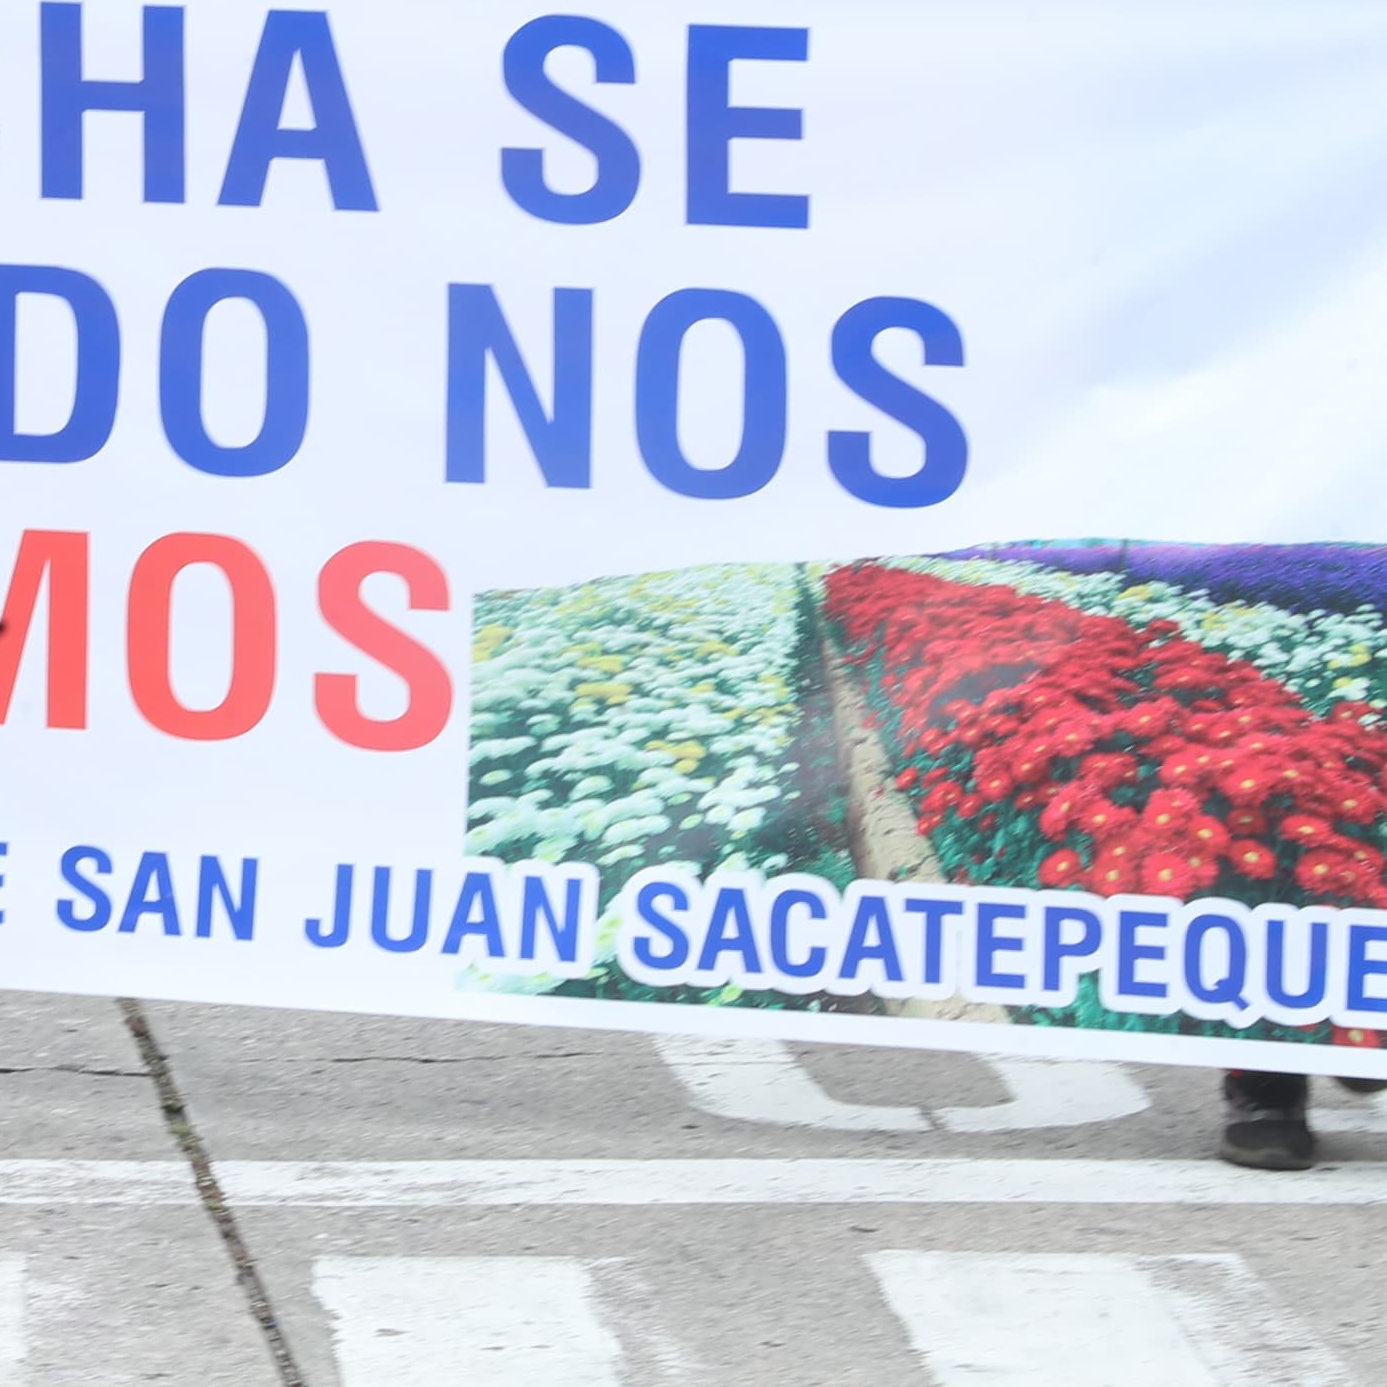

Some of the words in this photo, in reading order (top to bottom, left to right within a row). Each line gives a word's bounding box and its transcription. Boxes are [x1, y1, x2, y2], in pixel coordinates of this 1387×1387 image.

[499, 12, 812, 232] SE
[443, 281, 971, 511] NOS
[54, 843, 260, 943] SAN
[302, 862, 584, 964] JUAN
